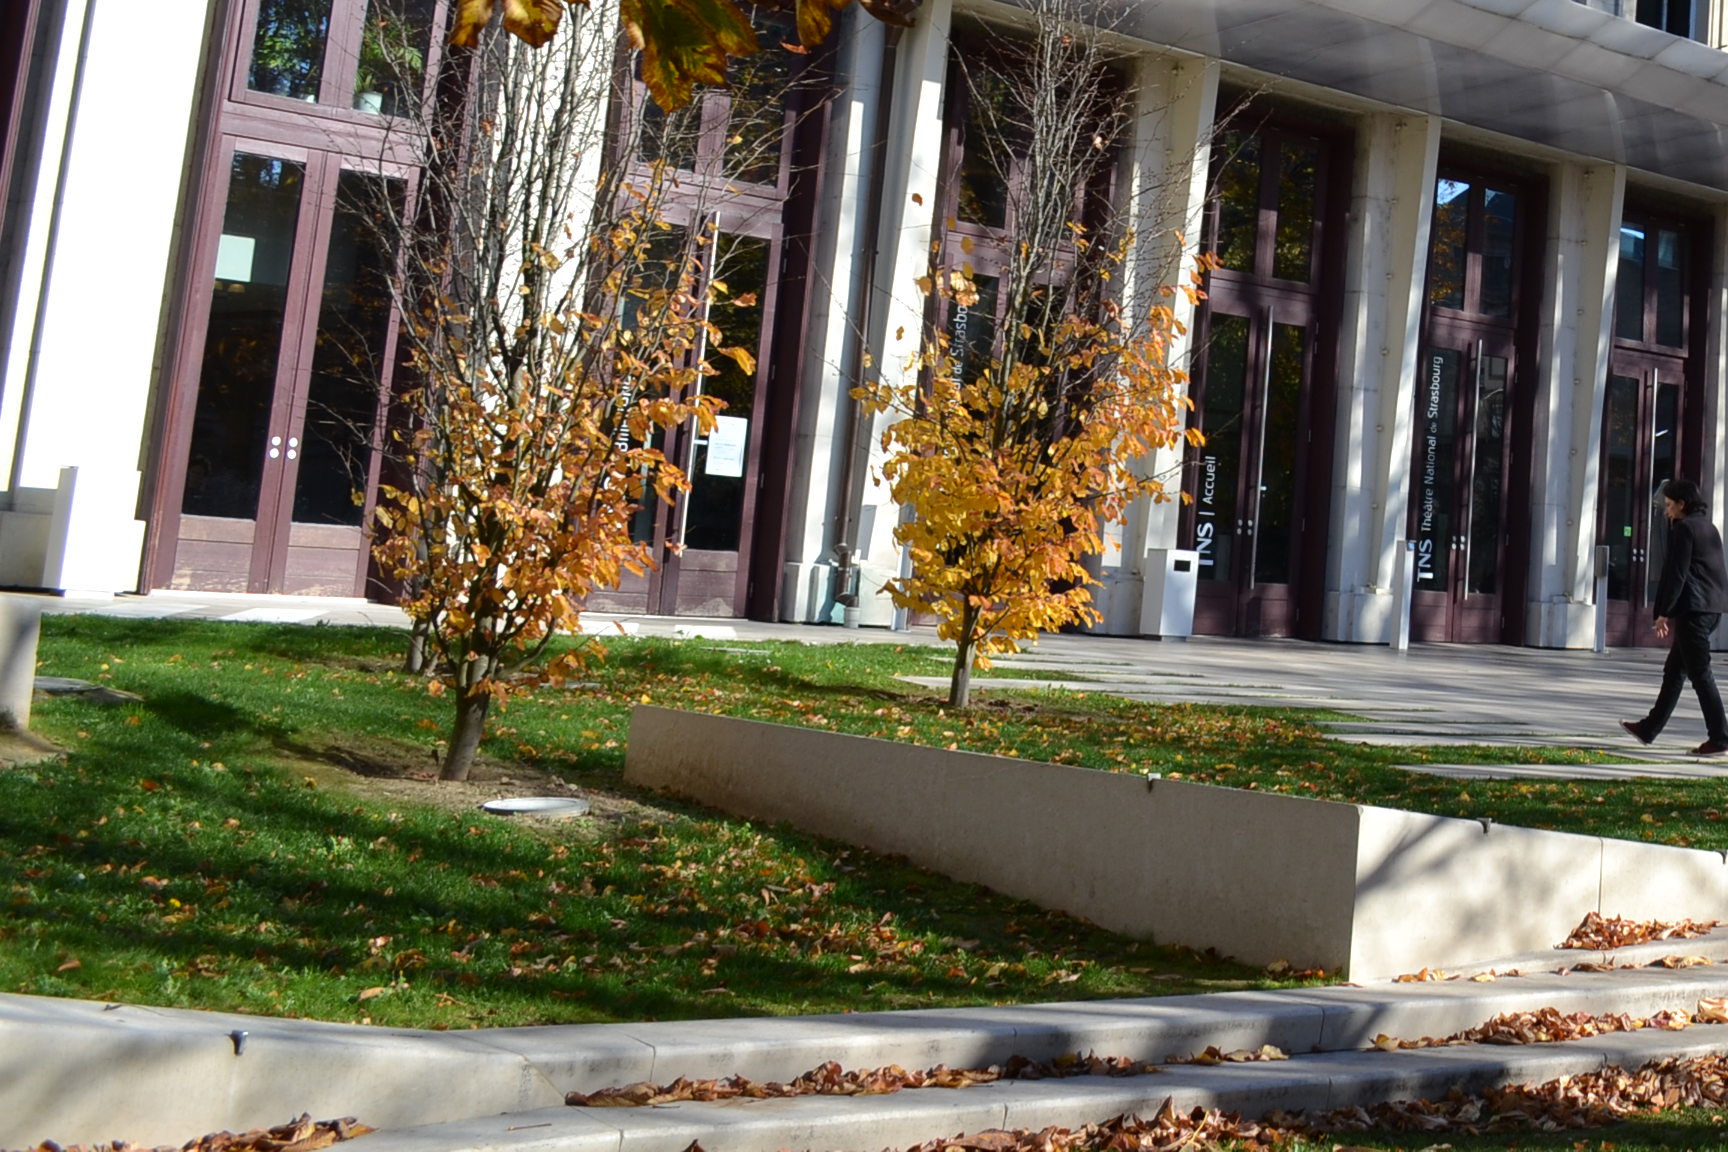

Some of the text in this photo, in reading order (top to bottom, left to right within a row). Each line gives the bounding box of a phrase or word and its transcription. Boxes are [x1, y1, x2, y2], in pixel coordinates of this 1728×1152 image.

[950, 305, 969, 357] Strasbo
[1428, 356, 1444, 419] Strasbourg
[1202, 455, 1217, 505] Accueil
[1424, 436, 1437, 485] National
[1417, 538, 1434, 583] TNS
